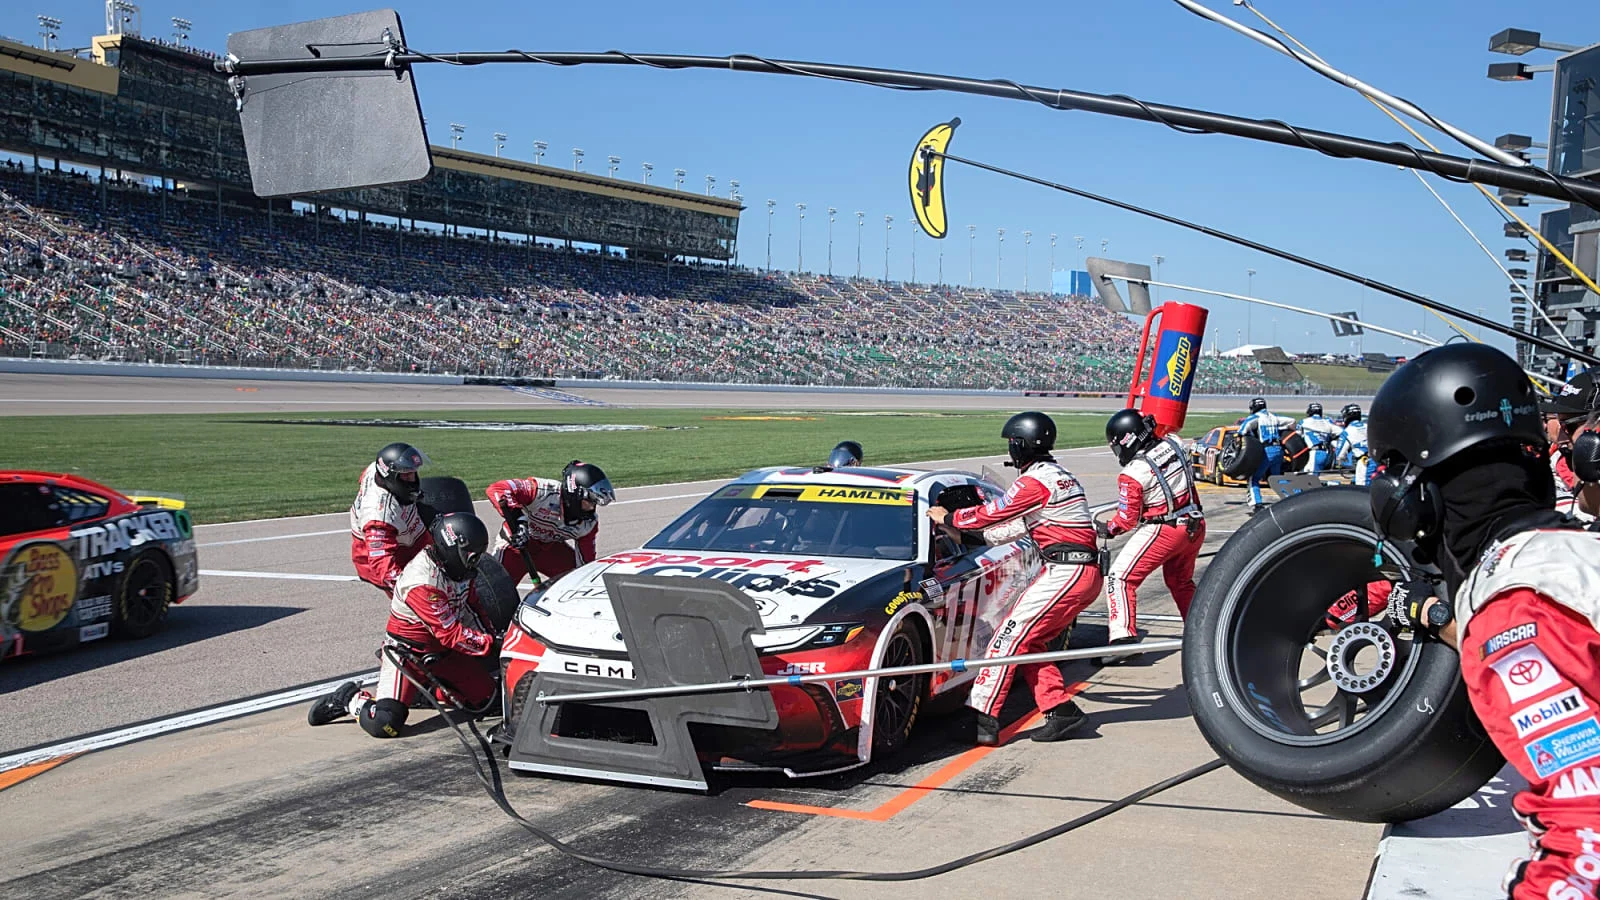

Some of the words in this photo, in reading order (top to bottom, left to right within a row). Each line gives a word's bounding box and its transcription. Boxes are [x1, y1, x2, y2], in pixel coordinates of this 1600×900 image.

[1170, 336, 1191, 396] SUNOCO
[1464, 410, 1498, 422] triple
[818, 489, 901, 501] HAMLIN
[70, 512, 179, 560] TRACKER
[82, 560, 125, 581] ATVs
[597, 551, 825, 574] Sport
[884, 591, 924, 616] GOODYEAR
[1488, 623, 1536, 652] NASCAR
[777, 662, 826, 675] JGR
[1517, 702, 1563, 732] Mobil
[1563, 695, 1580, 712] 1
[1551, 727, 1597, 748] SHERWIN
